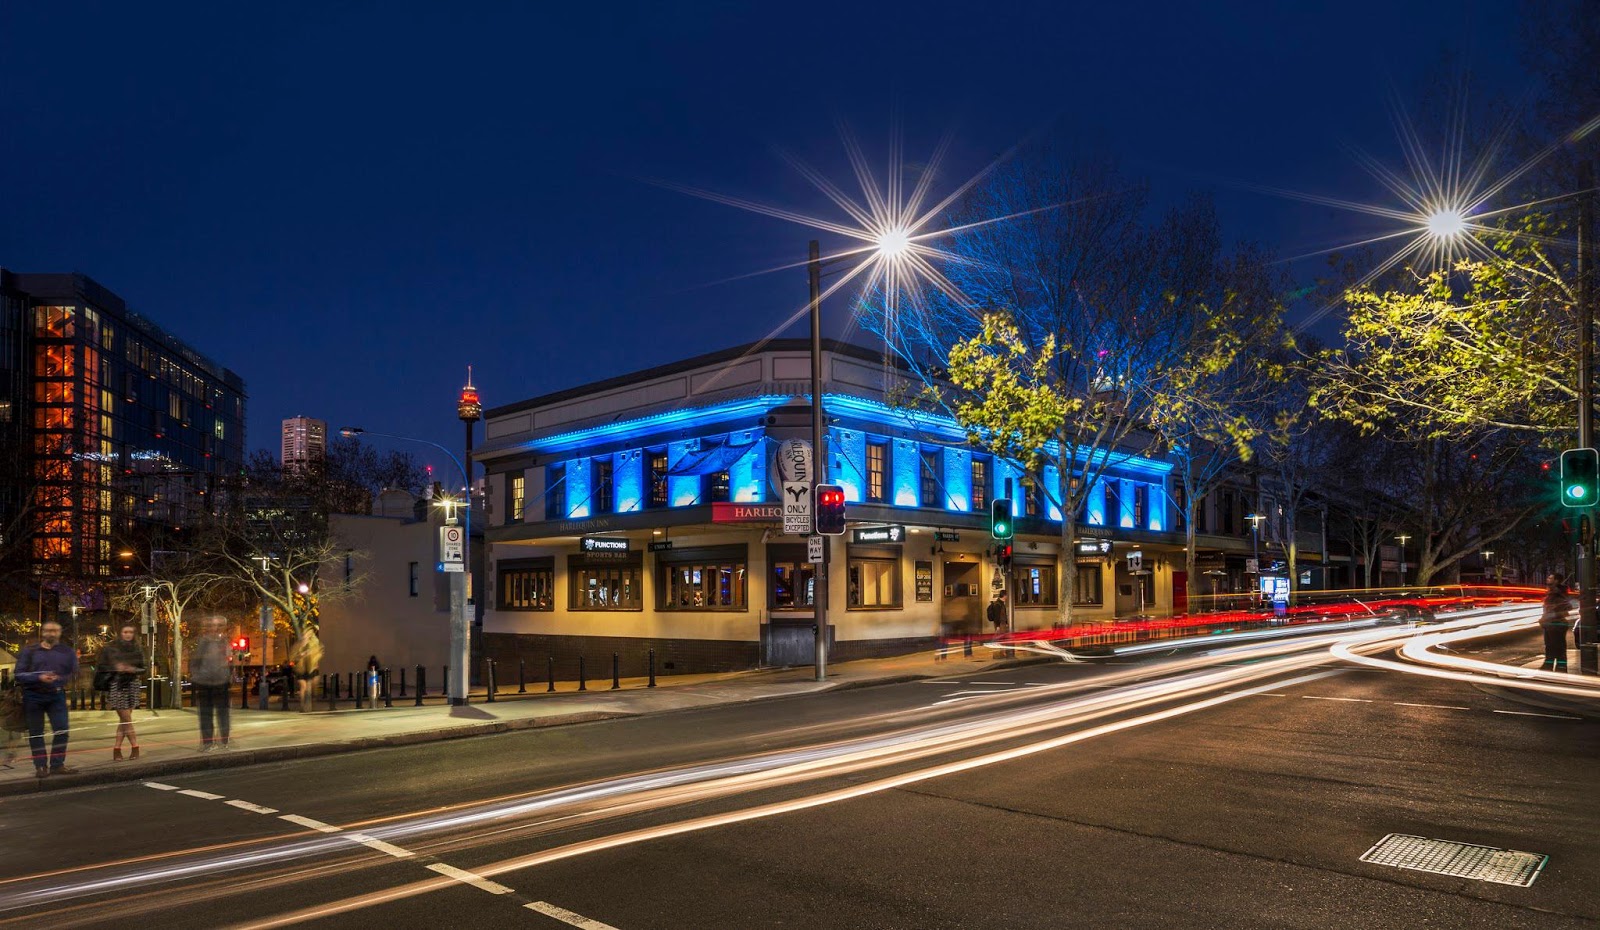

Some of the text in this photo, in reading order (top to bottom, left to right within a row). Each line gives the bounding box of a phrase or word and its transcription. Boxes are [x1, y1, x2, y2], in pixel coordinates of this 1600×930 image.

[735, 507, 784, 518] HARLEQ
[787, 504, 807, 514] ONLY
[785, 516, 810, 524] BICYCLES
[559, 519, 609, 532] HARLEQUIN INN
[785, 524, 810, 532] EXCEPTED
[859, 531, 888, 540] Functions
[594, 541, 627, 549] FUNCTIONS
[809, 538, 821, 546] ONE
[809, 546, 822, 554] WAY
